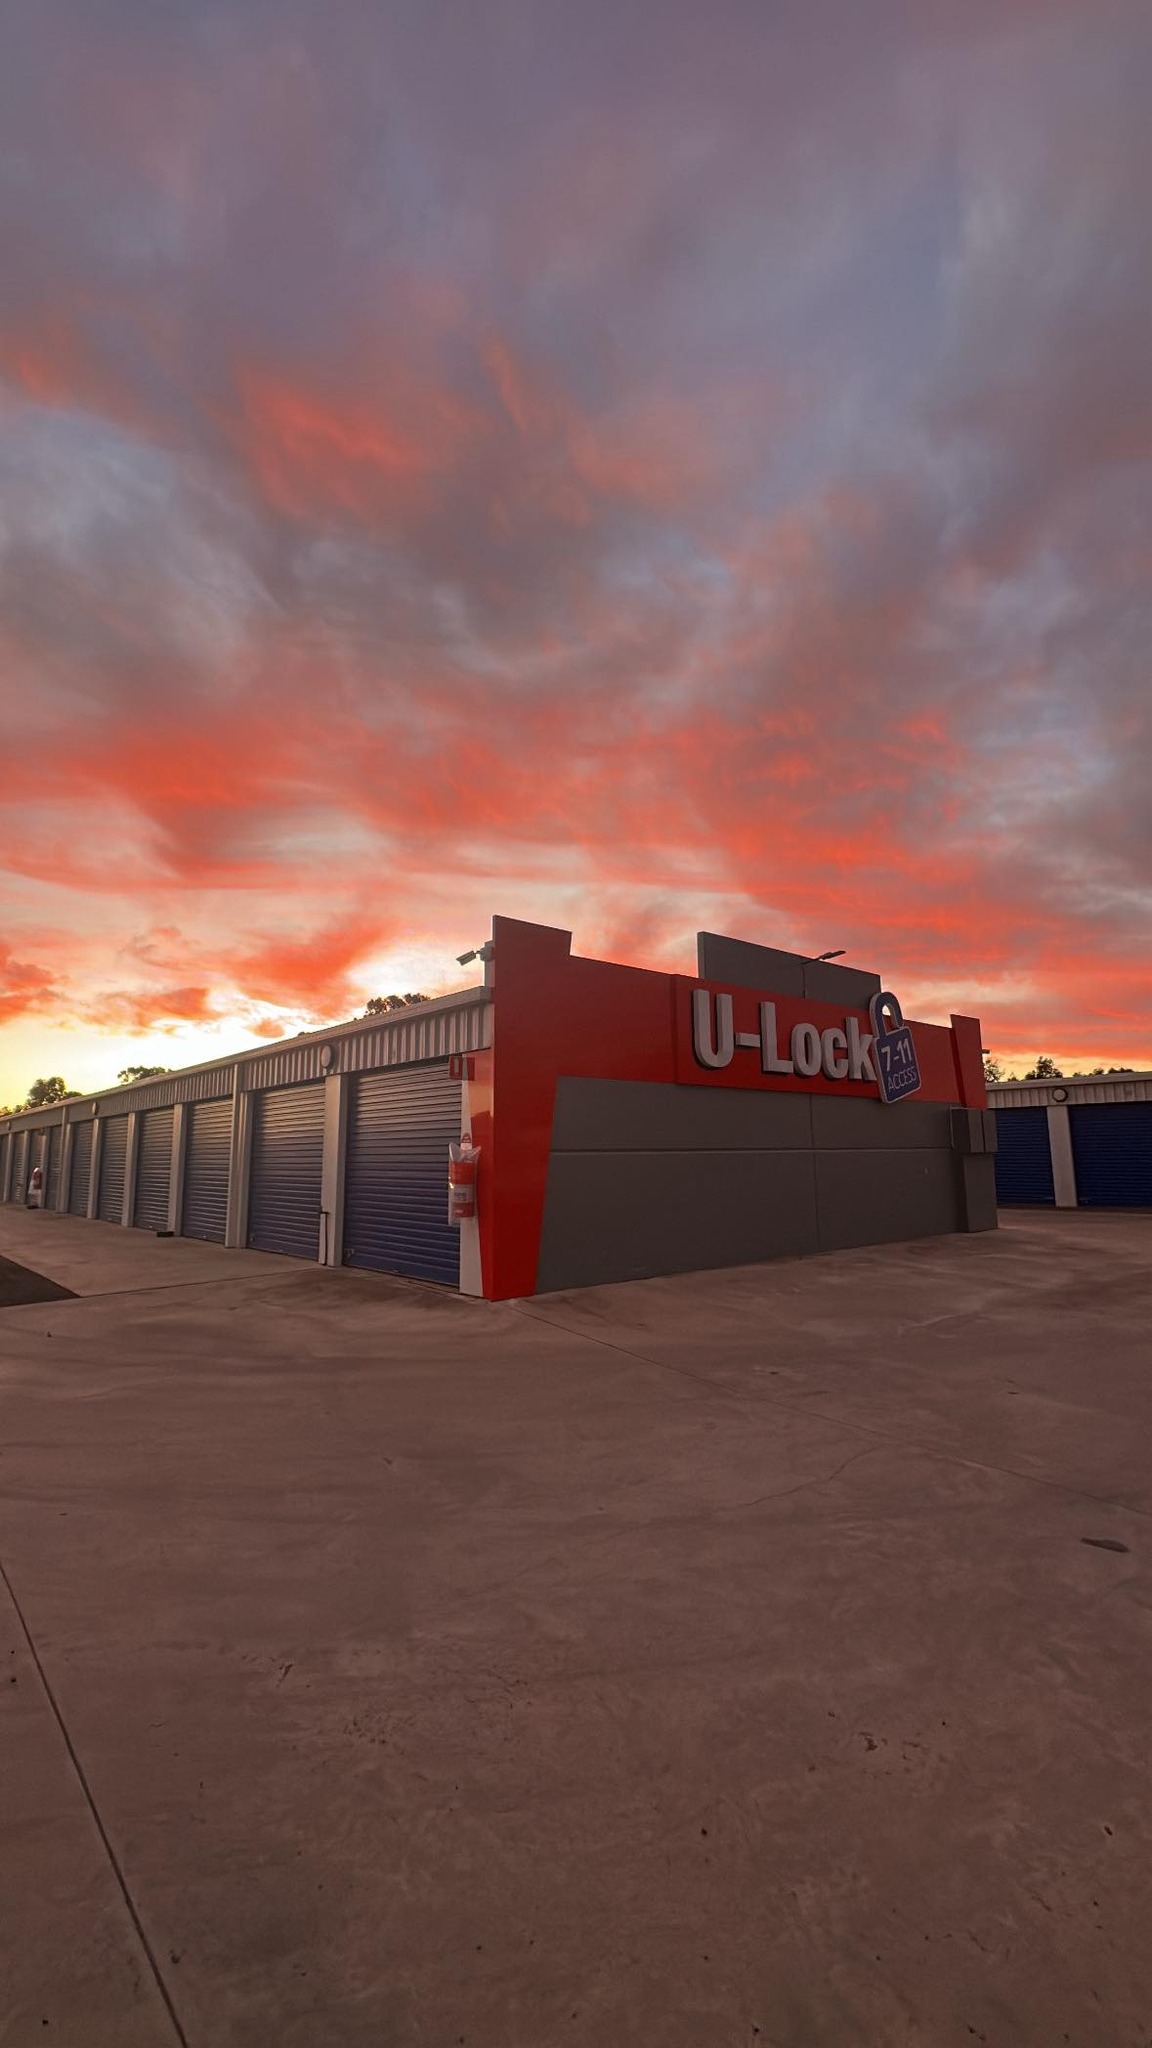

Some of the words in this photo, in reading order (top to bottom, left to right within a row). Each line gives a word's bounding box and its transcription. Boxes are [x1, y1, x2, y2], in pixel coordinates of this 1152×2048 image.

[693, 989, 877, 1081] U-Lock
[881, 1037, 912, 1072] 7-11
[887, 1066, 917, 1092] ACCESS
